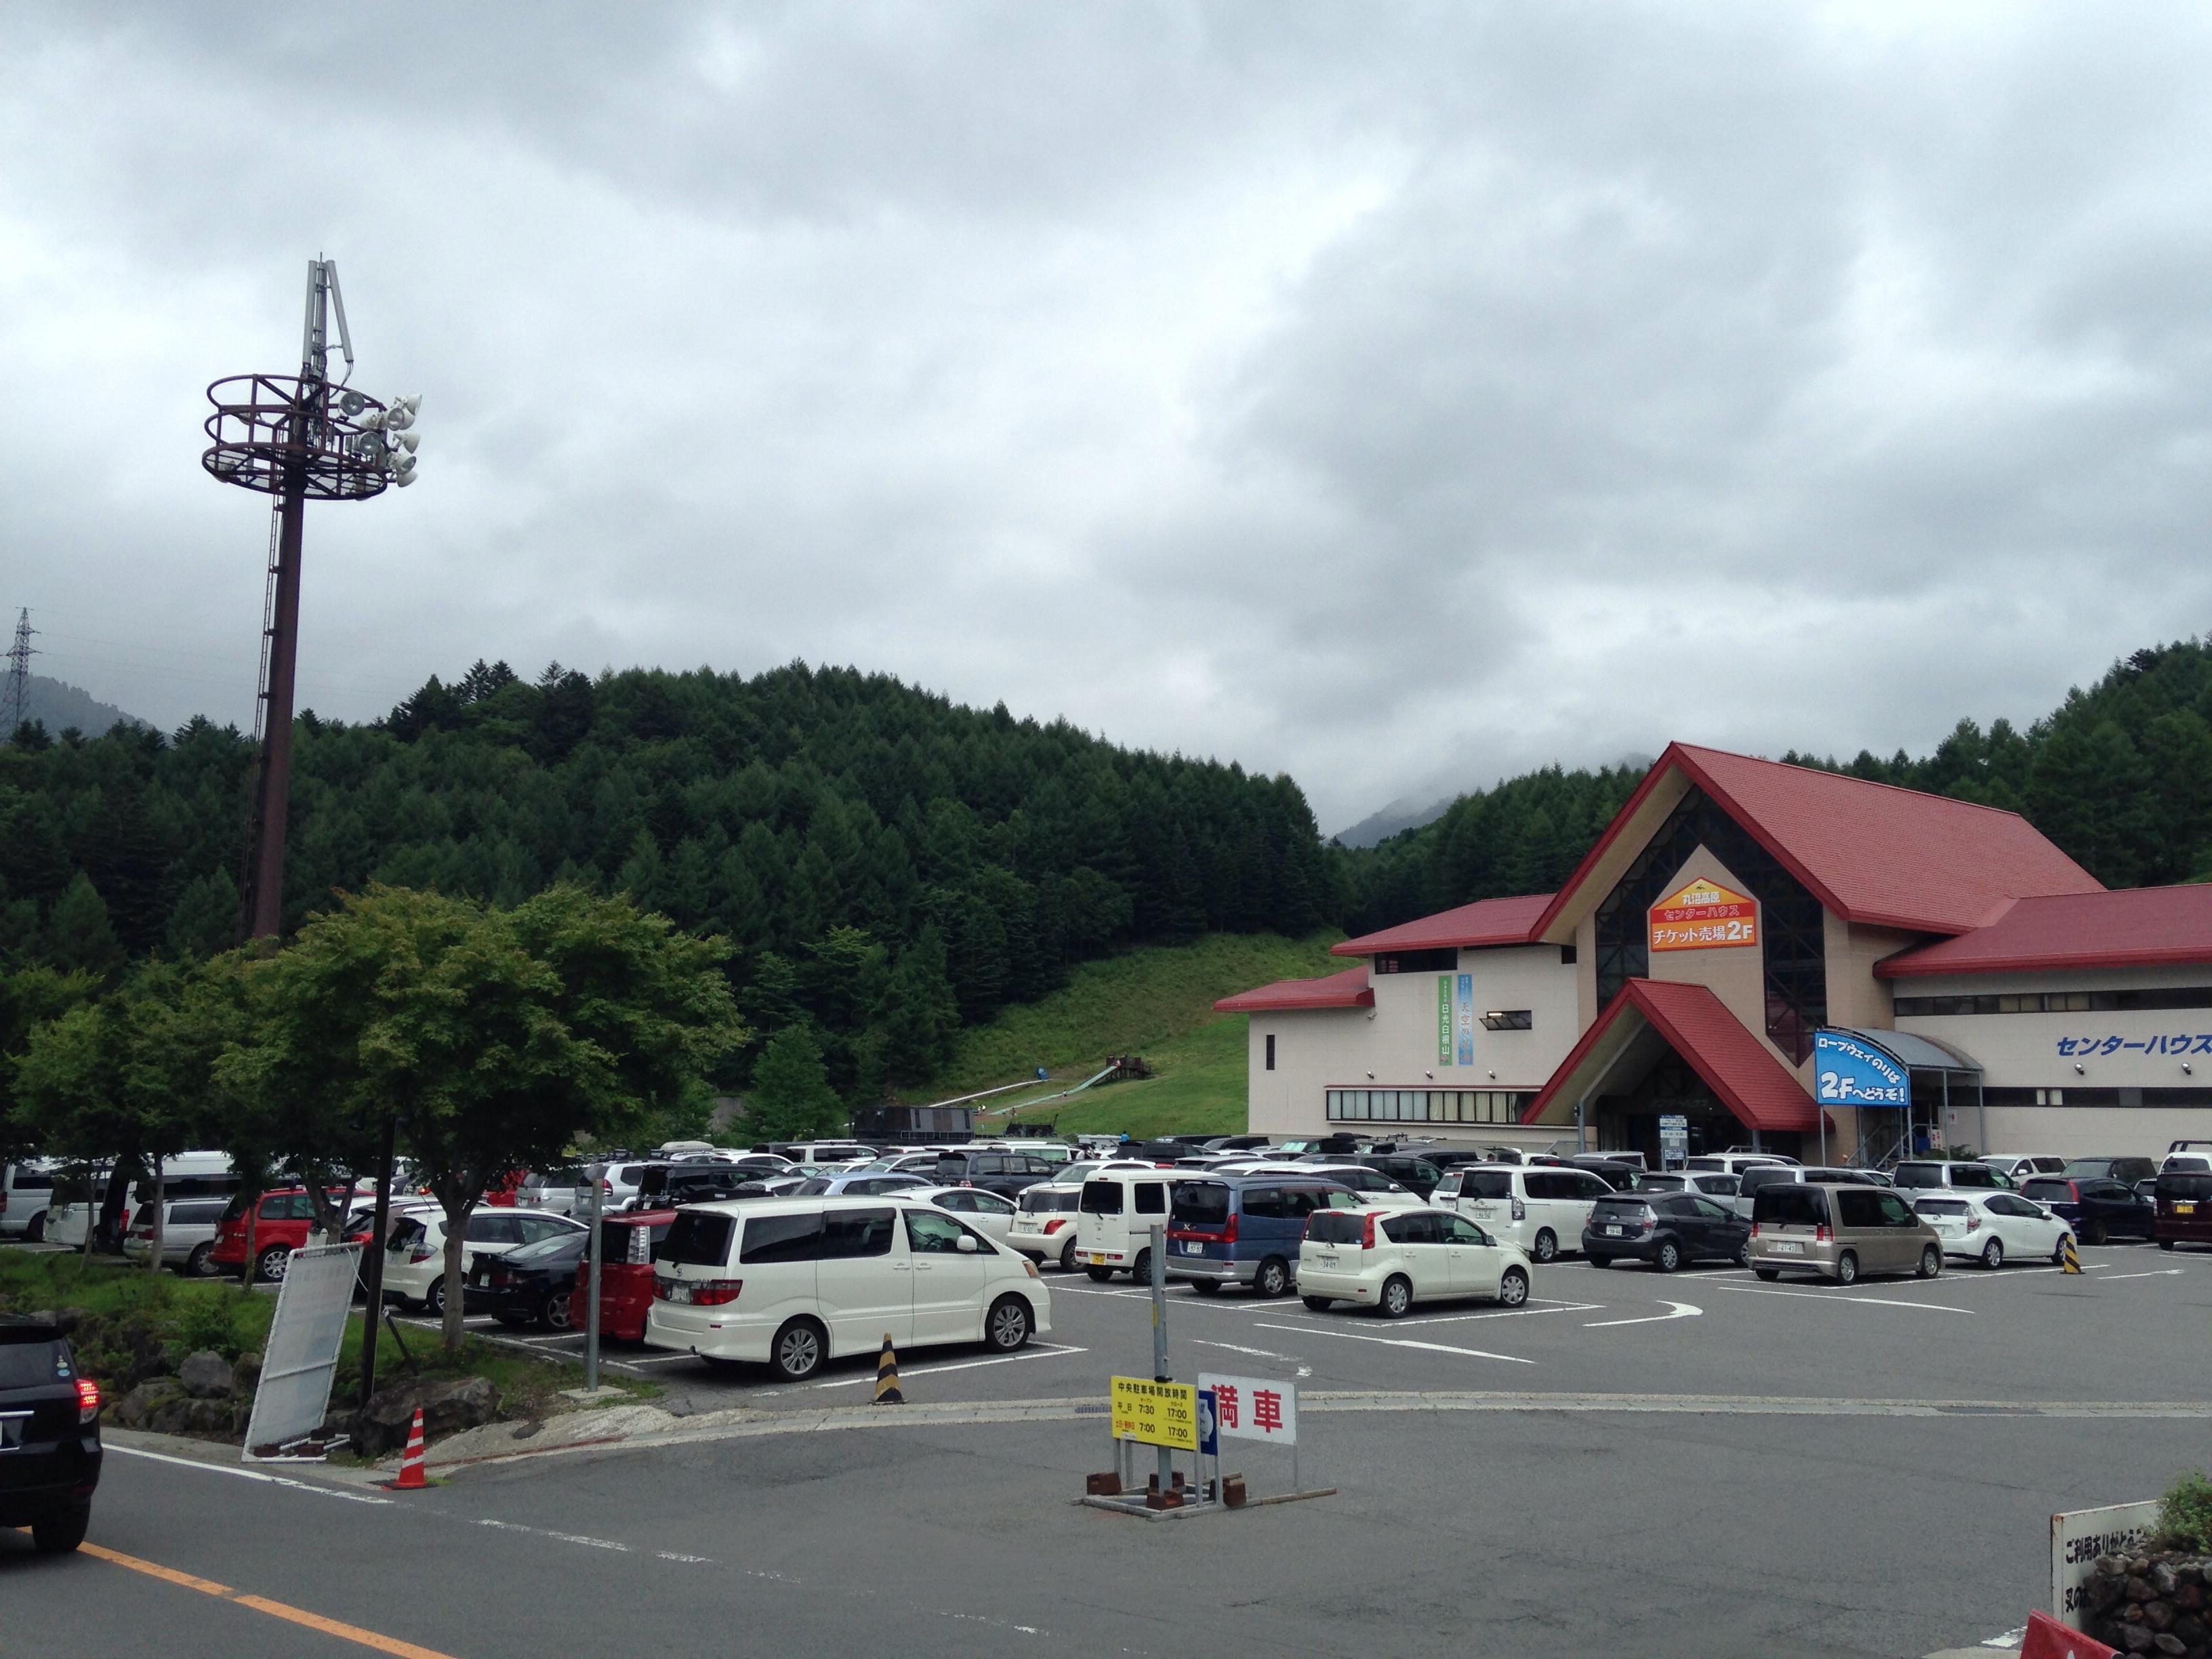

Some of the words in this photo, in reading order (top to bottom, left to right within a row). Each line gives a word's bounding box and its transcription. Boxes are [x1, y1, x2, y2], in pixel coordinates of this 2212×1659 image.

[1683, 891, 1720, 905] 丸沼高原
[1664, 905, 1740, 920] センターハウス
[1654, 921, 1753, 944] チケット売場2F
[2057, 1034, 2212, 1057] センターハウス
[1118, 1382, 1187, 1400] 中央駐車場開放時間
[1139, 1404, 1154, 1414] 7:30
[1167, 1408, 1187, 1419] 17:00
[1211, 1384, 1283, 1433] 満車
[1139, 1423, 1155, 1433] 7:00
[1168, 1427, 1187, 1438] 17:00
